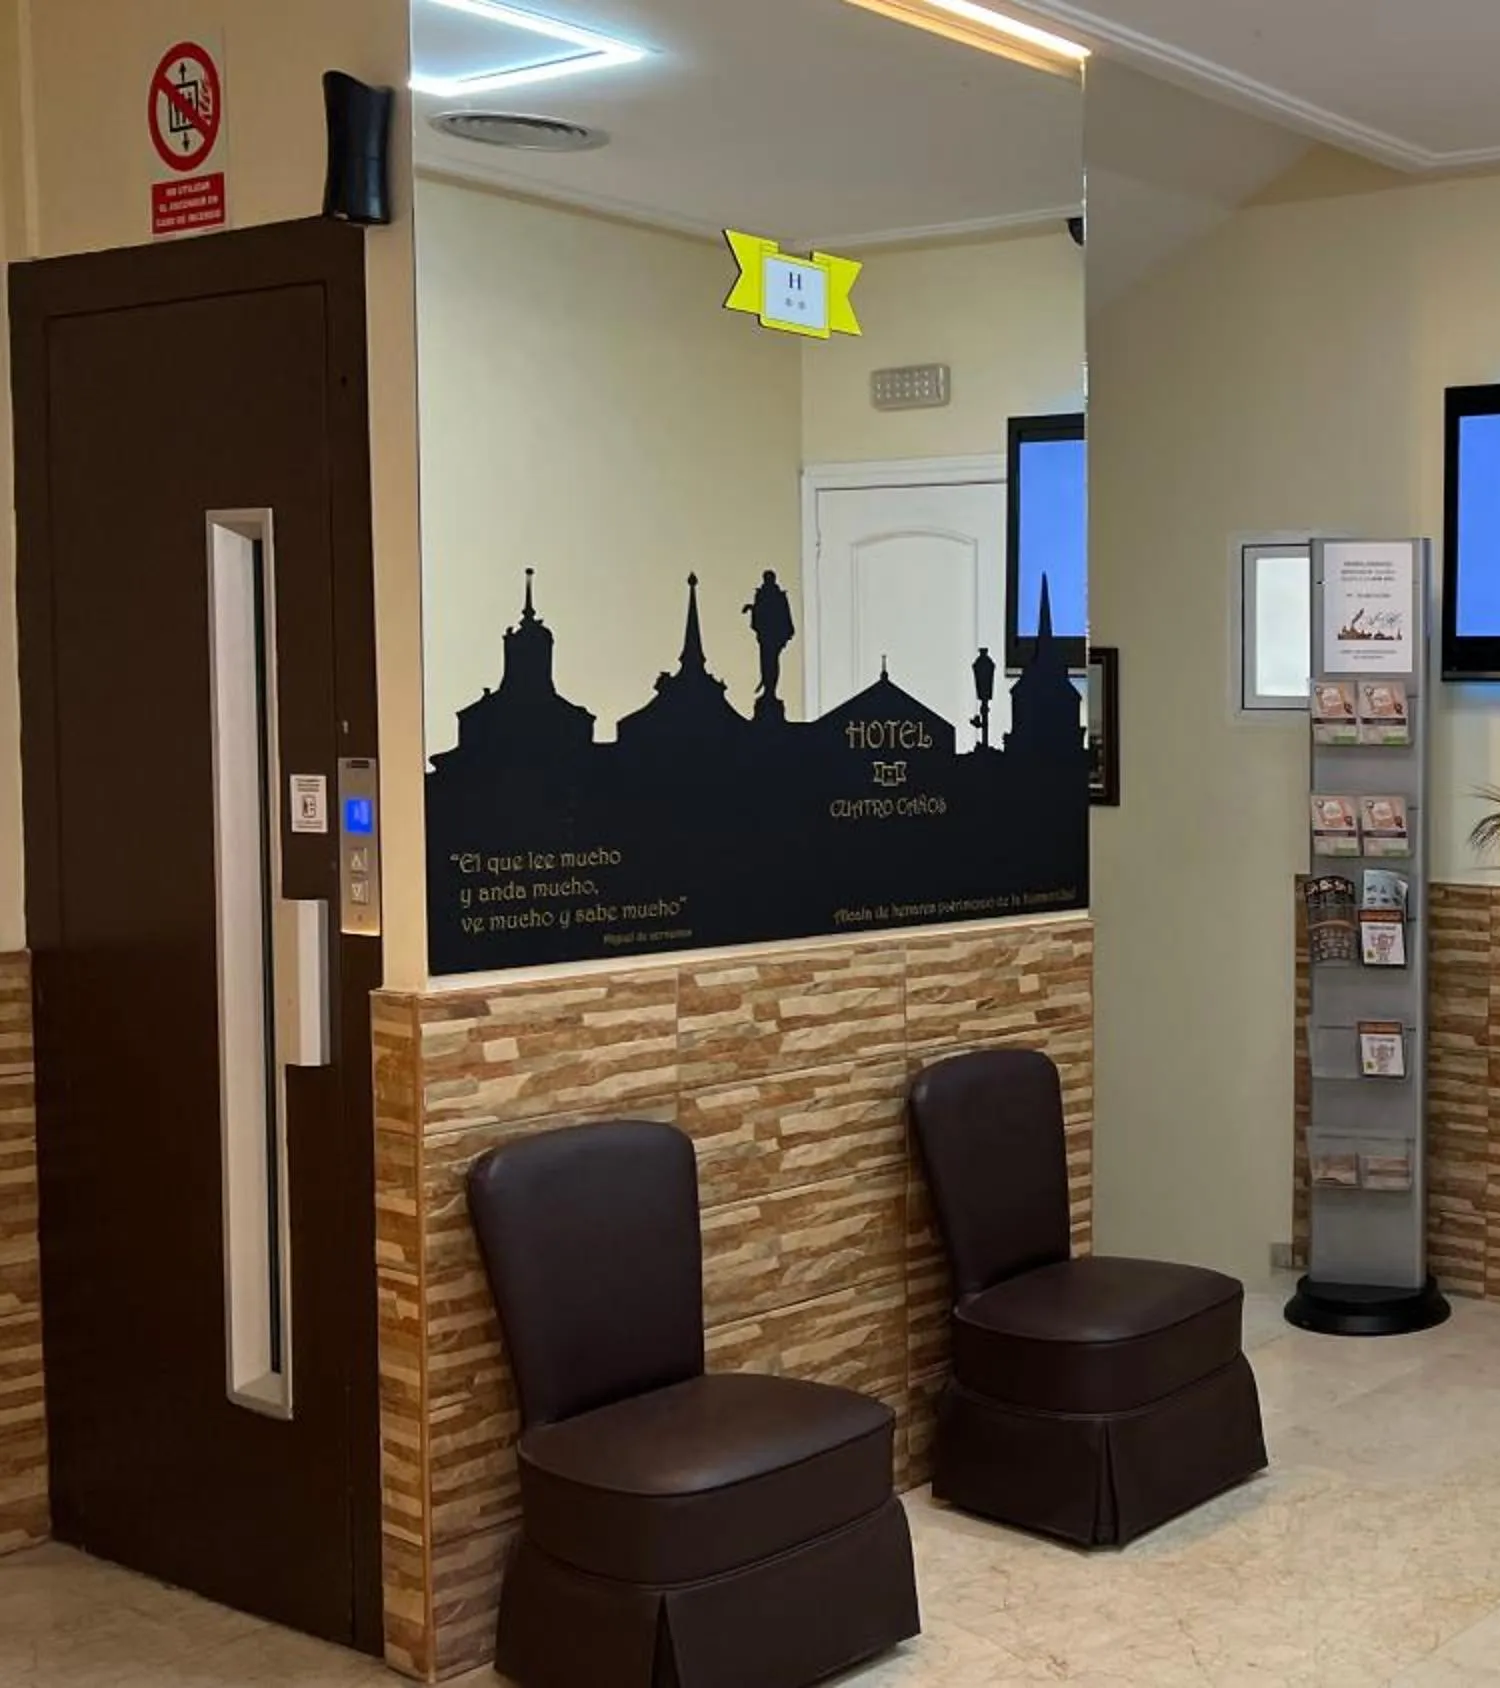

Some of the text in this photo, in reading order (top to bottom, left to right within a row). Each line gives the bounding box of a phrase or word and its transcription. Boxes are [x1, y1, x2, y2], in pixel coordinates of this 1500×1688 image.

[788, 271, 802, 290] H
[844, 720, 933, 749] HOTEL
[829, 793, 947, 819] CUATRO CAÑOS
[487, 854, 523, 876] que
[529, 851, 556, 870] lee
[561, 847, 622, 868] mucho
[460, 887, 472, 909] y
[479, 881, 527, 902] anda
[461, 914, 485, 934] ve
[490, 908, 555, 932] mucho
[559, 909, 571, 928] y
[575, 903, 619, 924] sabe
